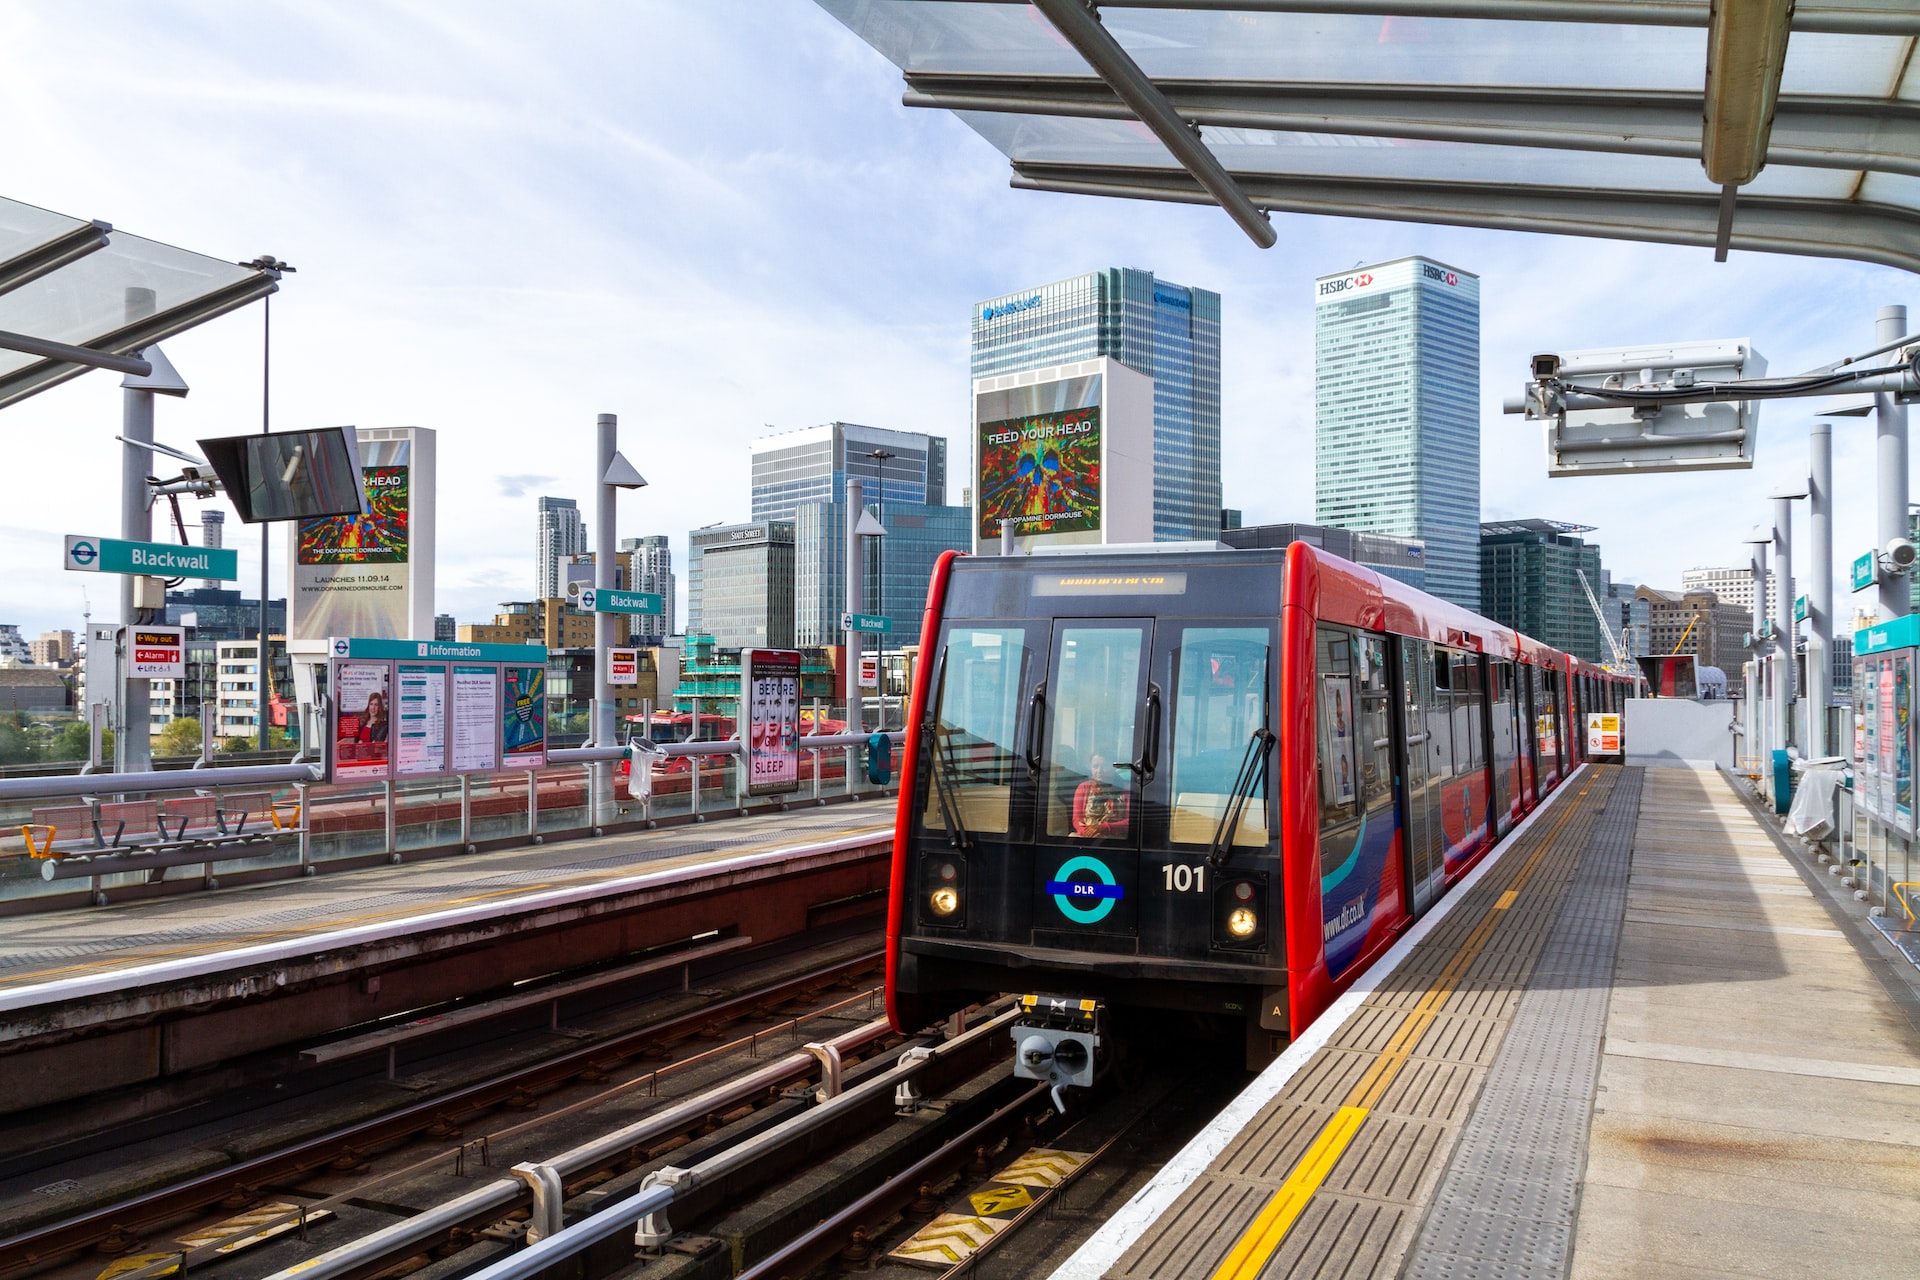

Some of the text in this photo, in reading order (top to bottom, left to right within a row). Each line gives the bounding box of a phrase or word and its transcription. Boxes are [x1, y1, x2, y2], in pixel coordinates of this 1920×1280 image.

[1423, 264, 1446, 282] HSBC
[1319, 277, 1354, 296] HSBC
[988, 421, 1092, 445] FEED YOUR HEAD
[370, 477, 401, 486] HEAD
[1045, 511, 1082, 521] DORMOUSE
[325, 547, 356, 555] DOPAMINE
[358, 546, 393, 554] DORMOUSE
[132, 549, 209, 570] Blackwall
[357, 575, 390, 583] 11.09.14
[610, 595, 648, 609] Blackwall
[861, 618, 884, 629] Blackwall
[144, 634, 172, 644] Way out
[144, 651, 165, 660] Alarm
[430, 645, 481, 657] Information
[144, 664, 157, 672] Lift
[759, 684, 794, 696] BEFORE
[516, 698, 531, 707] FREE
[765, 735, 776, 748] GO
[755, 760, 784, 774] SLEEP
[1162, 864, 1204, 893] 101
[1074, 884, 1095, 895] DLR
[1324, 895, 1365, 941] www.dlr.co.uk
[1272, 1005, 1281, 1016] A
